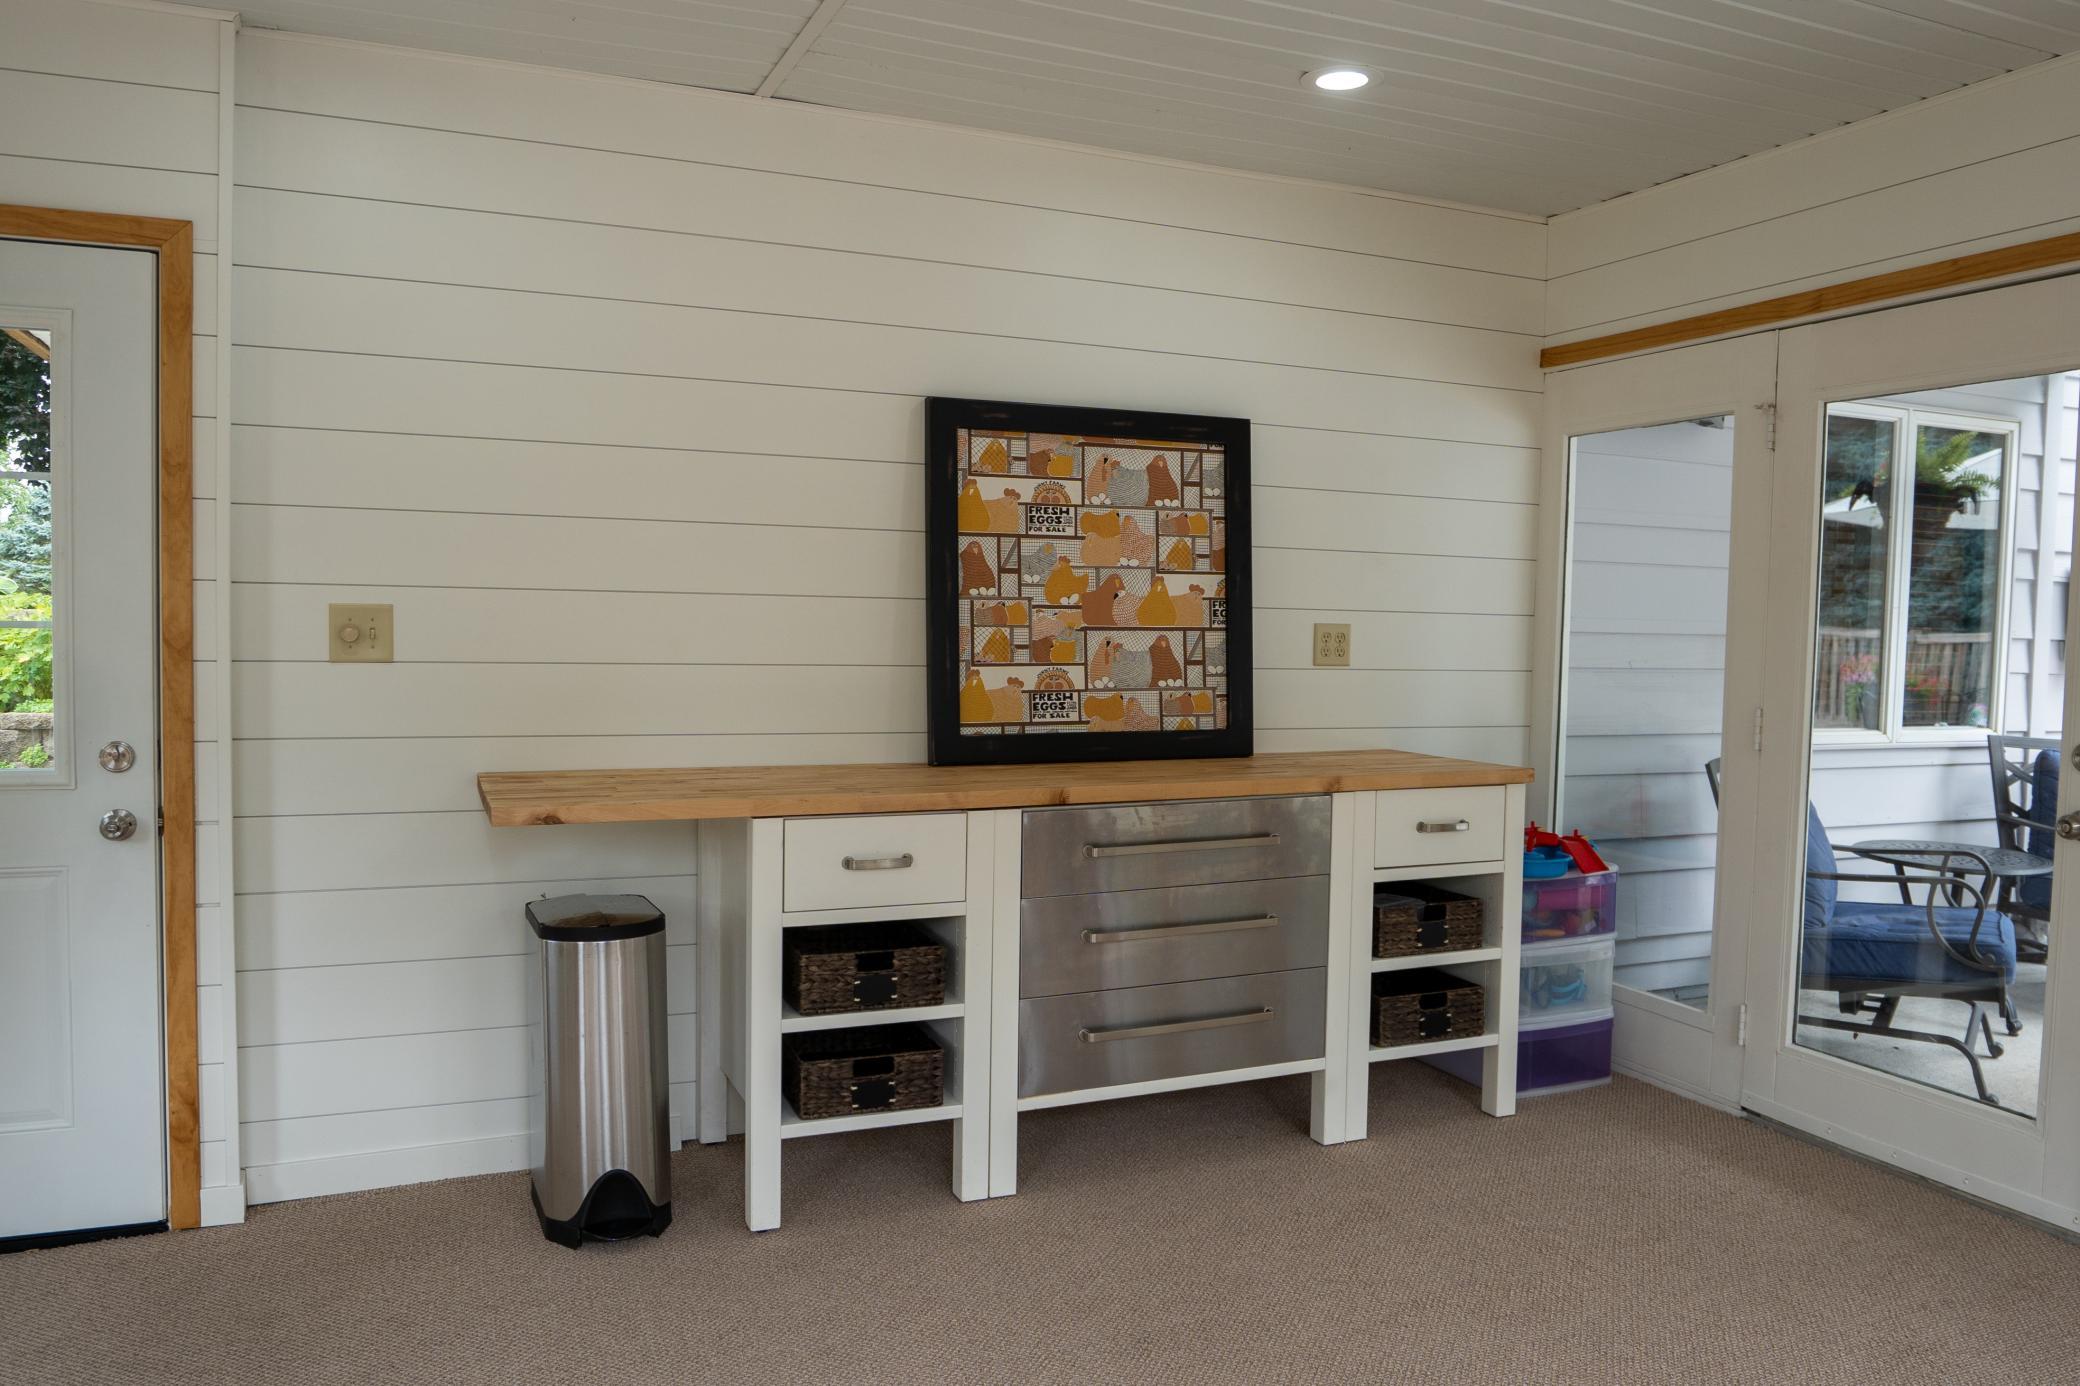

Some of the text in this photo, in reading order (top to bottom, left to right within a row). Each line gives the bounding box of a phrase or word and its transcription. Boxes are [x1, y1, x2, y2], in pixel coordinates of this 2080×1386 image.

[1029, 506, 1070, 515] FRESH
[1029, 515, 1062, 524] EGGS
[1033, 693, 1073, 701] FRESH
[1033, 702, 1066, 711] EGGS
